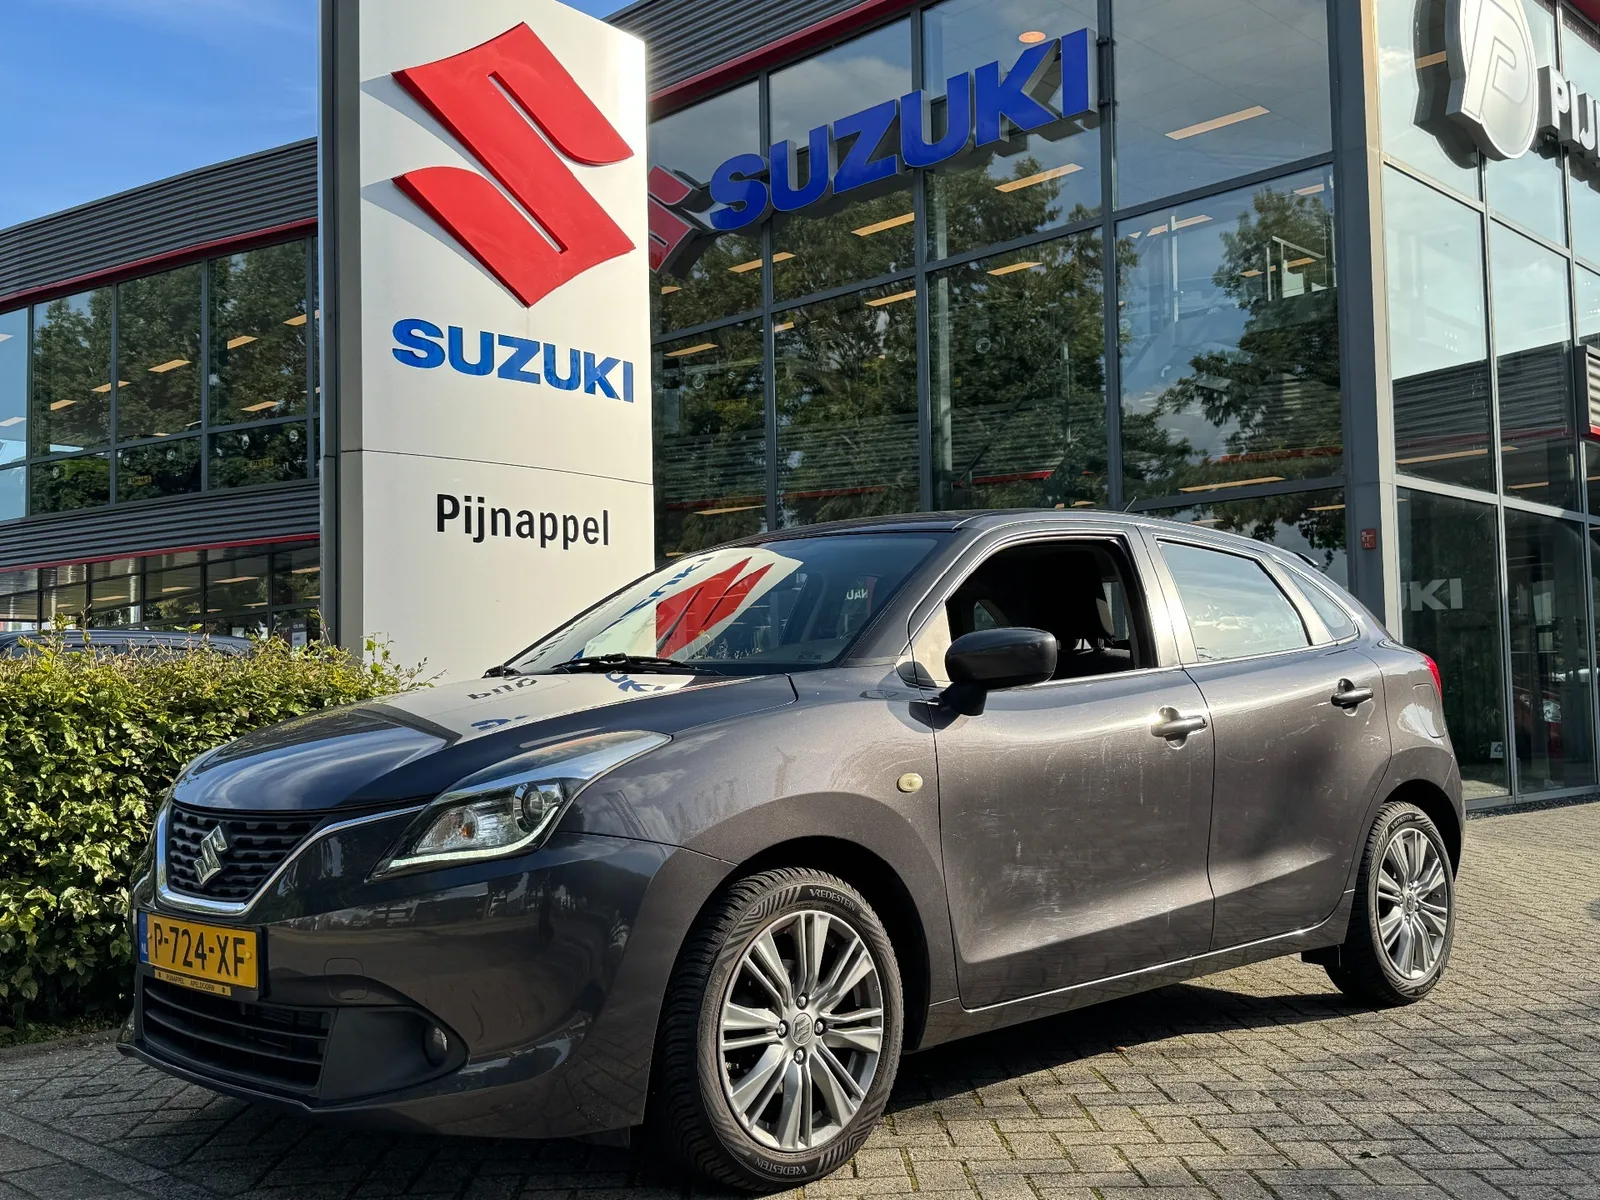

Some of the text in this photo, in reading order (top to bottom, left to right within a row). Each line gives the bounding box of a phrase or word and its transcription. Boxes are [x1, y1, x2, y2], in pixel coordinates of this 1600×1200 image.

[709, 27, 1093, 231] SUZUKI
[1546, 65, 1600, 158] PIJ
[392, 318, 634, 404] SUZUKI
[436, 493, 609, 551] Pijnappel
[809, 887, 857, 912] VREDESTEIN
[153, 922, 246, 977] P-724-XF
[755, 1156, 808, 1175] VREDESTEIN
